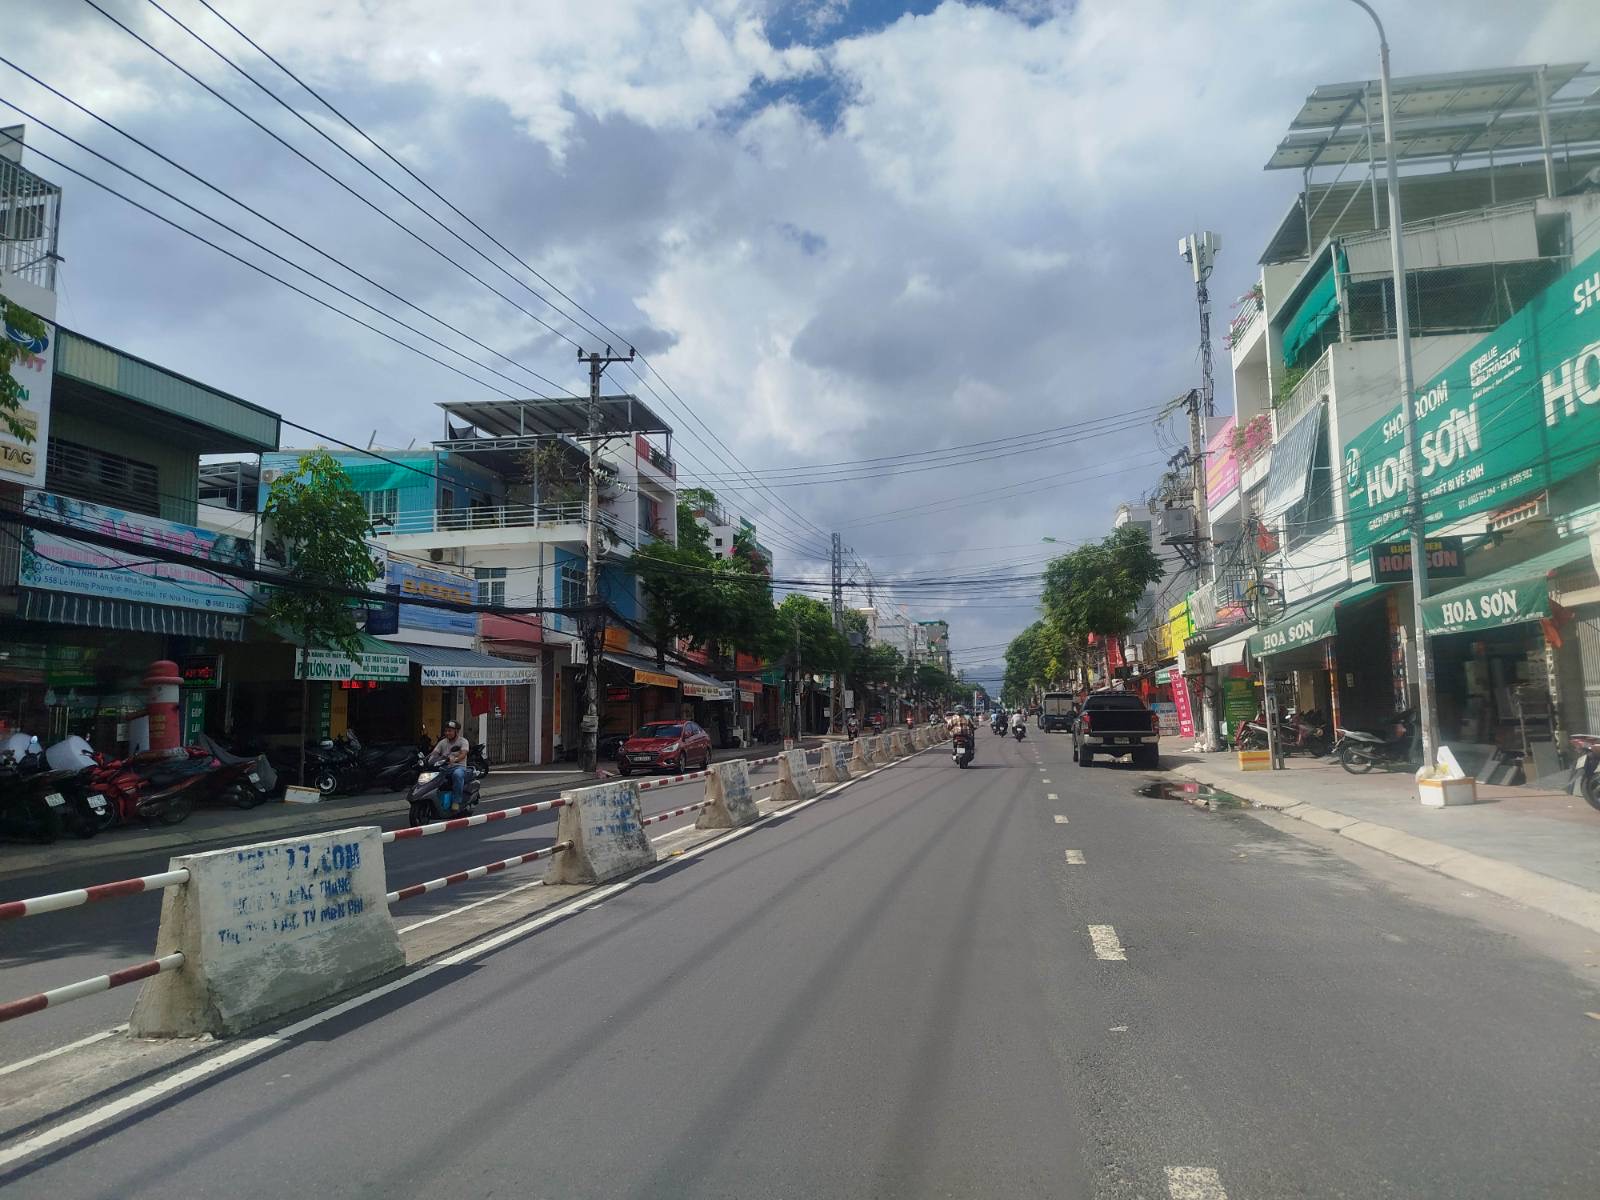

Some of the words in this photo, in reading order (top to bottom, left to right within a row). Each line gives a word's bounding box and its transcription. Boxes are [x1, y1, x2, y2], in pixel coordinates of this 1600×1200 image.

[1383, 380, 1448, 443] SHOROOM
[1420, 402, 1481, 477] SƠN
[1465, 463, 1484, 483] SINH
[1441, 599, 1478, 625] HOA
[1480, 588, 1517, 619] SƠN
[1263, 630, 1287, 650] HOA
[1288, 619, 1314, 642] SƠN
[334, 663, 351, 678] ANH
